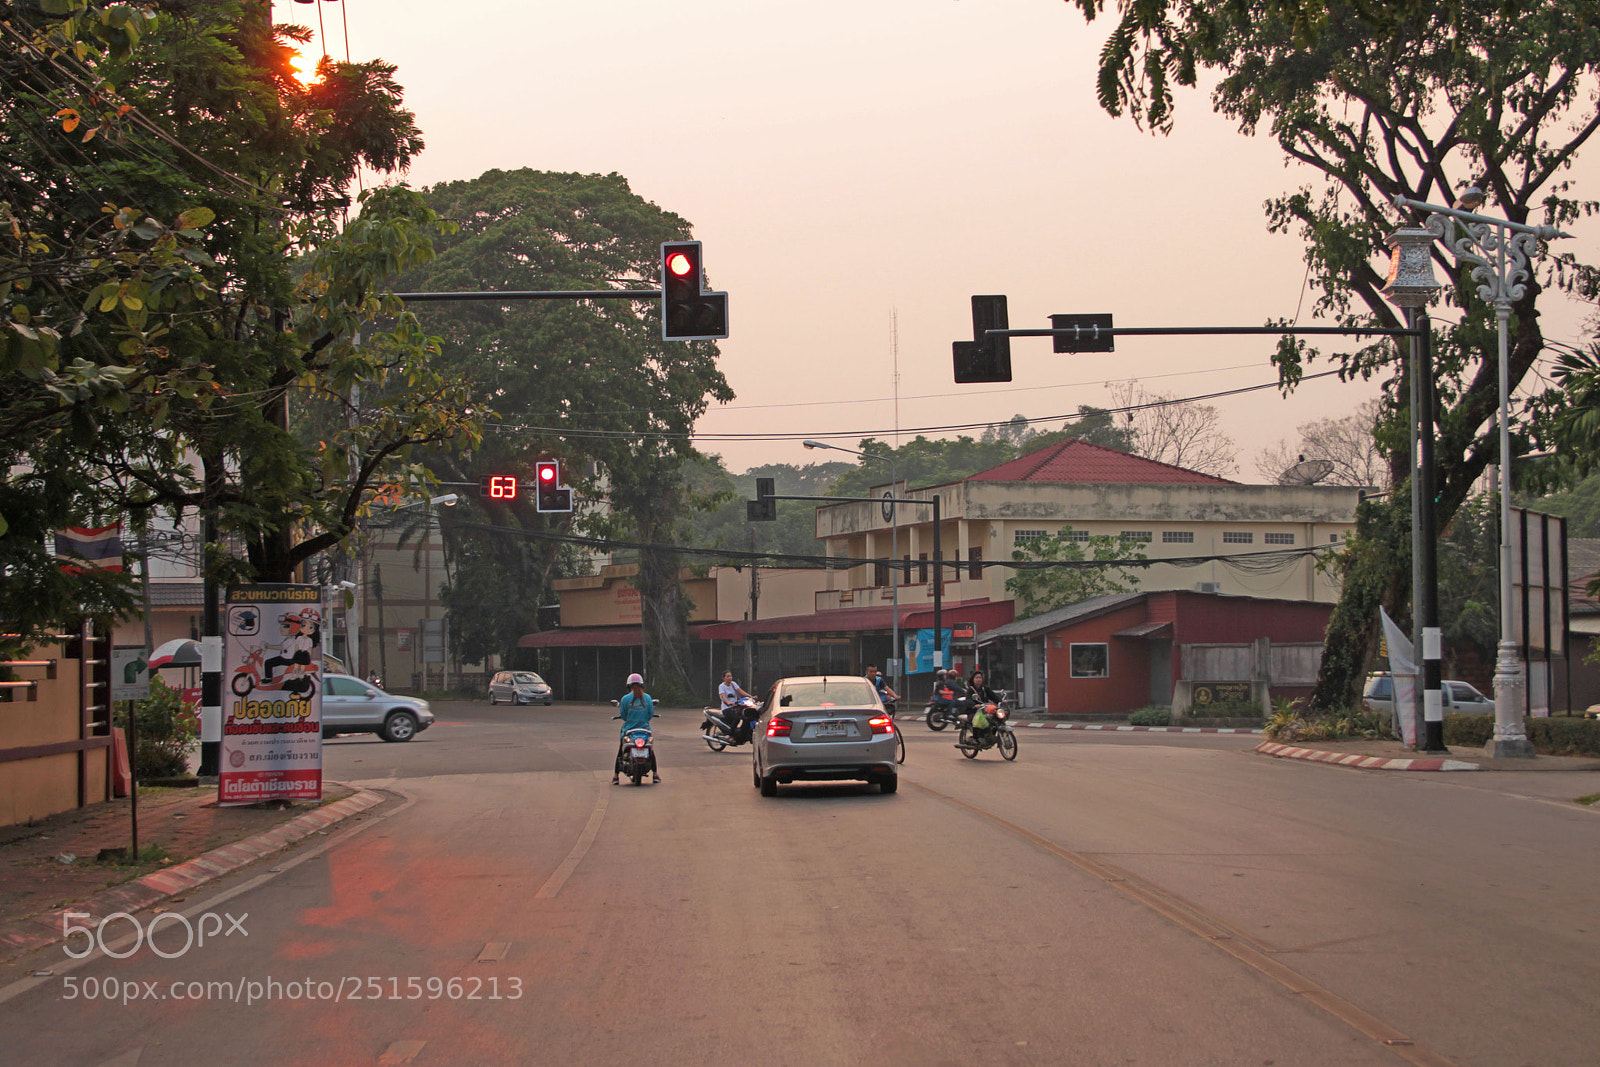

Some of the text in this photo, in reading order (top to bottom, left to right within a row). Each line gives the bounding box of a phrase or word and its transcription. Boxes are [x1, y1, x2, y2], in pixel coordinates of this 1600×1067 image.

[490, 476, 516, 499] 63
[231, 587, 318, 601] สวมหมวกนิรภัย
[233, 694, 312, 719] ปลอดภัย
[224, 778, 318, 793] โตโยต้าเชียงราย
